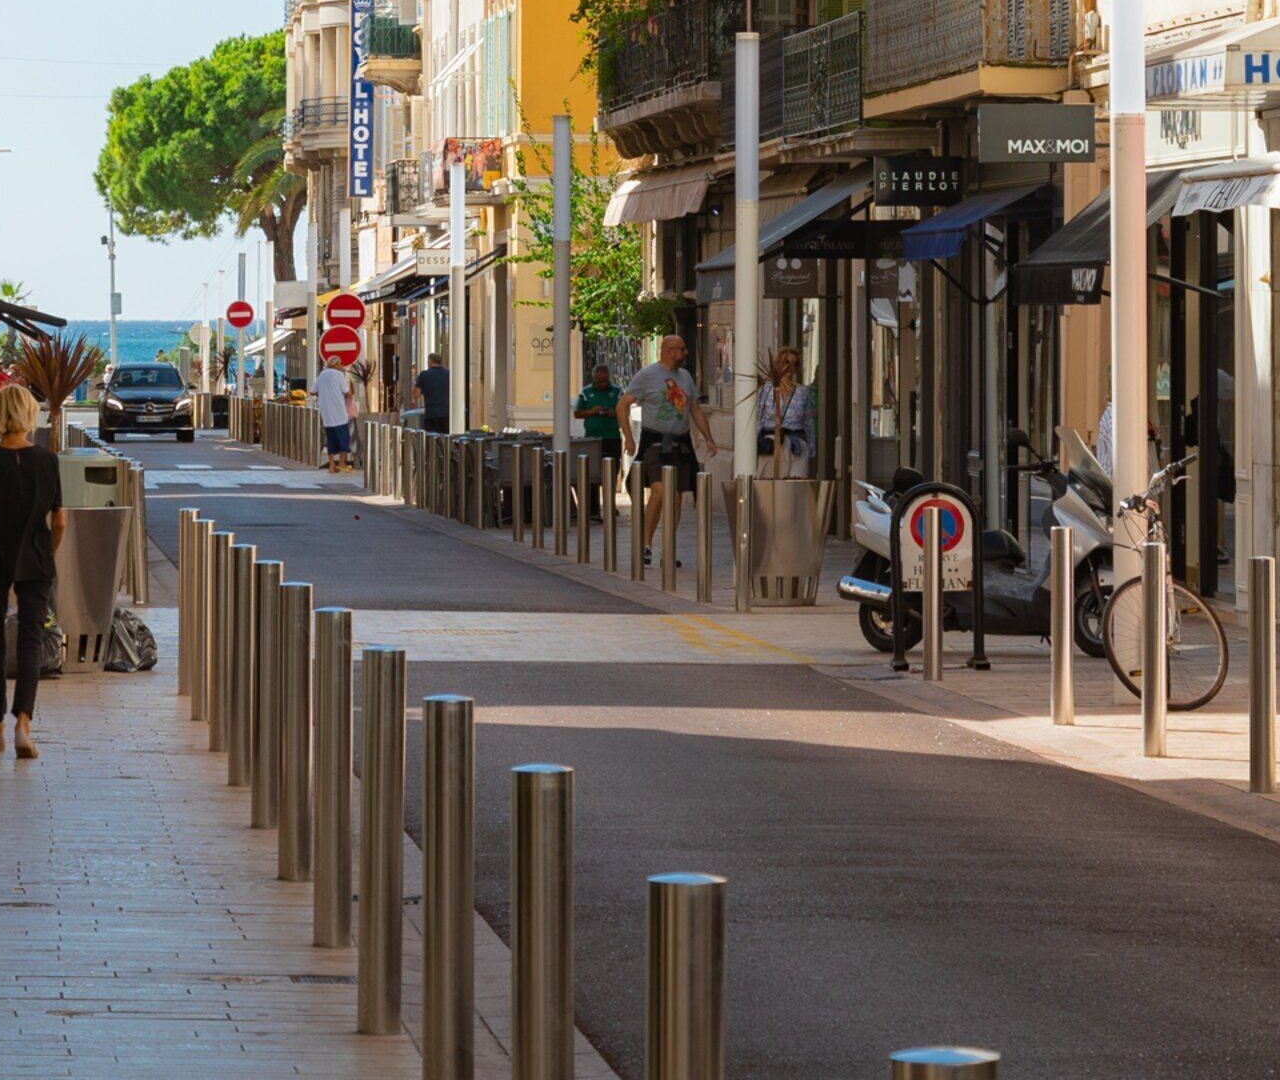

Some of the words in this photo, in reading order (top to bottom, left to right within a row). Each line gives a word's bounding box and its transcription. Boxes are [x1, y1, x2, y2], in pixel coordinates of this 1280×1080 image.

[1152, 59, 1207, 95] FLORIAN
[353, 109, 369, 195] HOTEL
[1007, 139, 1089, 154] MAX&MOI
[879, 172, 959, 181] CLAUDIE
[879, 182, 959, 191] PIERLOT
[531, 338, 554, 351] ap
[908, 577, 966, 589] FLAN
